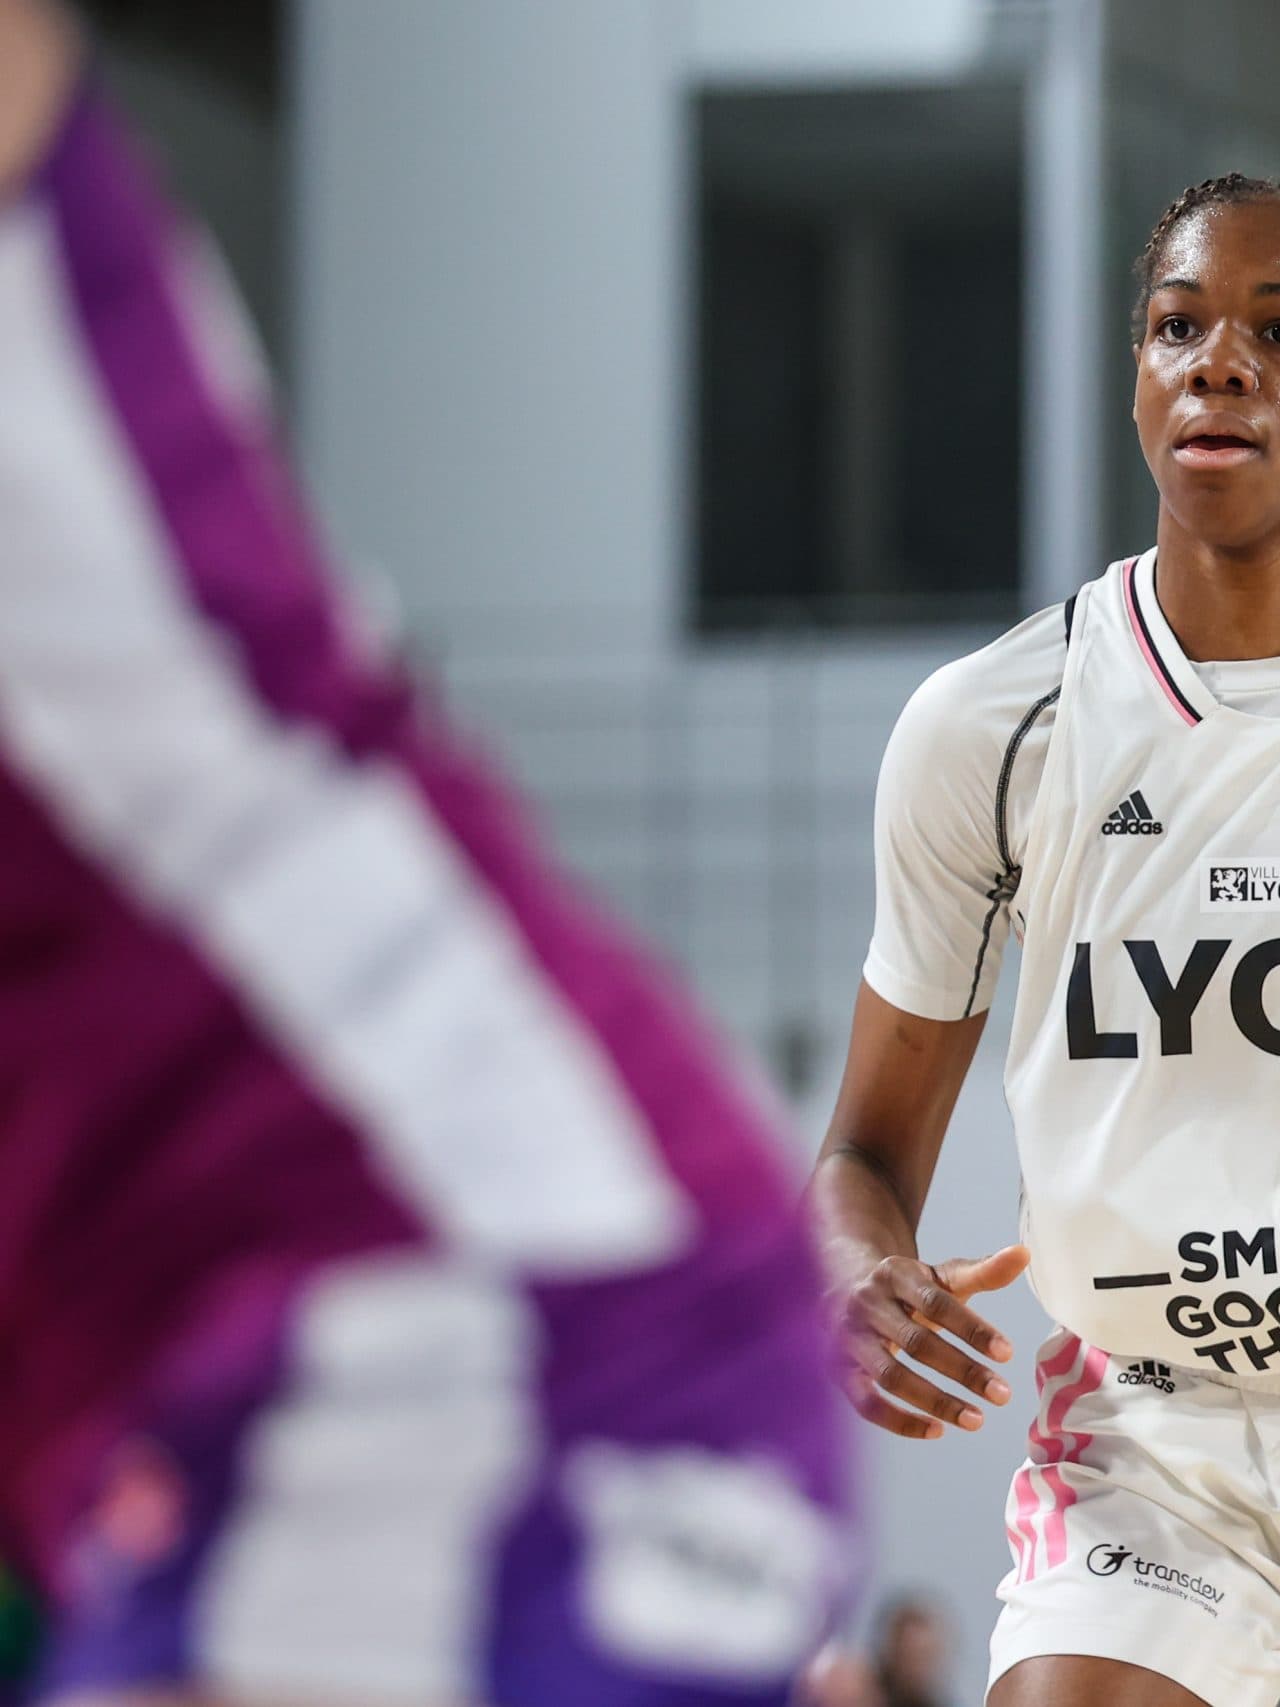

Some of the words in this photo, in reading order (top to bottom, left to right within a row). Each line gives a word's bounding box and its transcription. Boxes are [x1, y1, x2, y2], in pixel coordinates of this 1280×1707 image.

[1101, 816, 1163, 835] adidas
[1133, 1557, 1224, 1603] transdev
[1133, 1577, 1149, 1587] the
[1151, 1583, 1189, 1600] mobility
